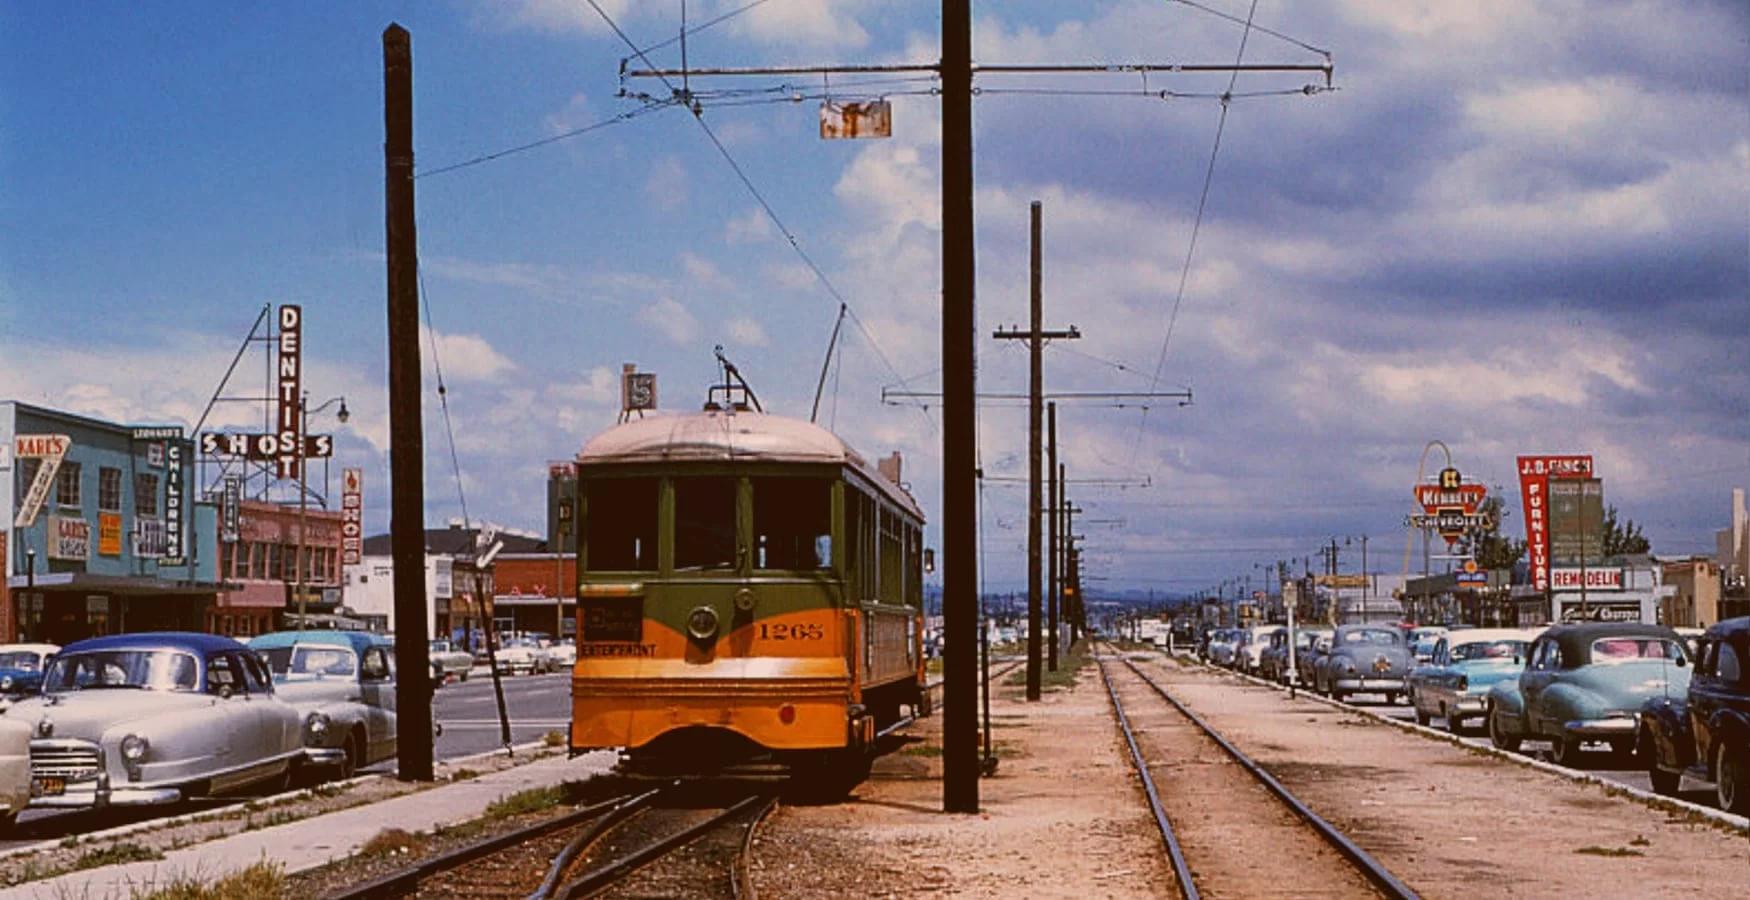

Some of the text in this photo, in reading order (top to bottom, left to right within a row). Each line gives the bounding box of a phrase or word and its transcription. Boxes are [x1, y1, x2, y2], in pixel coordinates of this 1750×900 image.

[279, 307, 298, 476] DENTIST
[1528, 483, 1548, 591] FURNITURE
[760, 623, 823, 640] 1265
